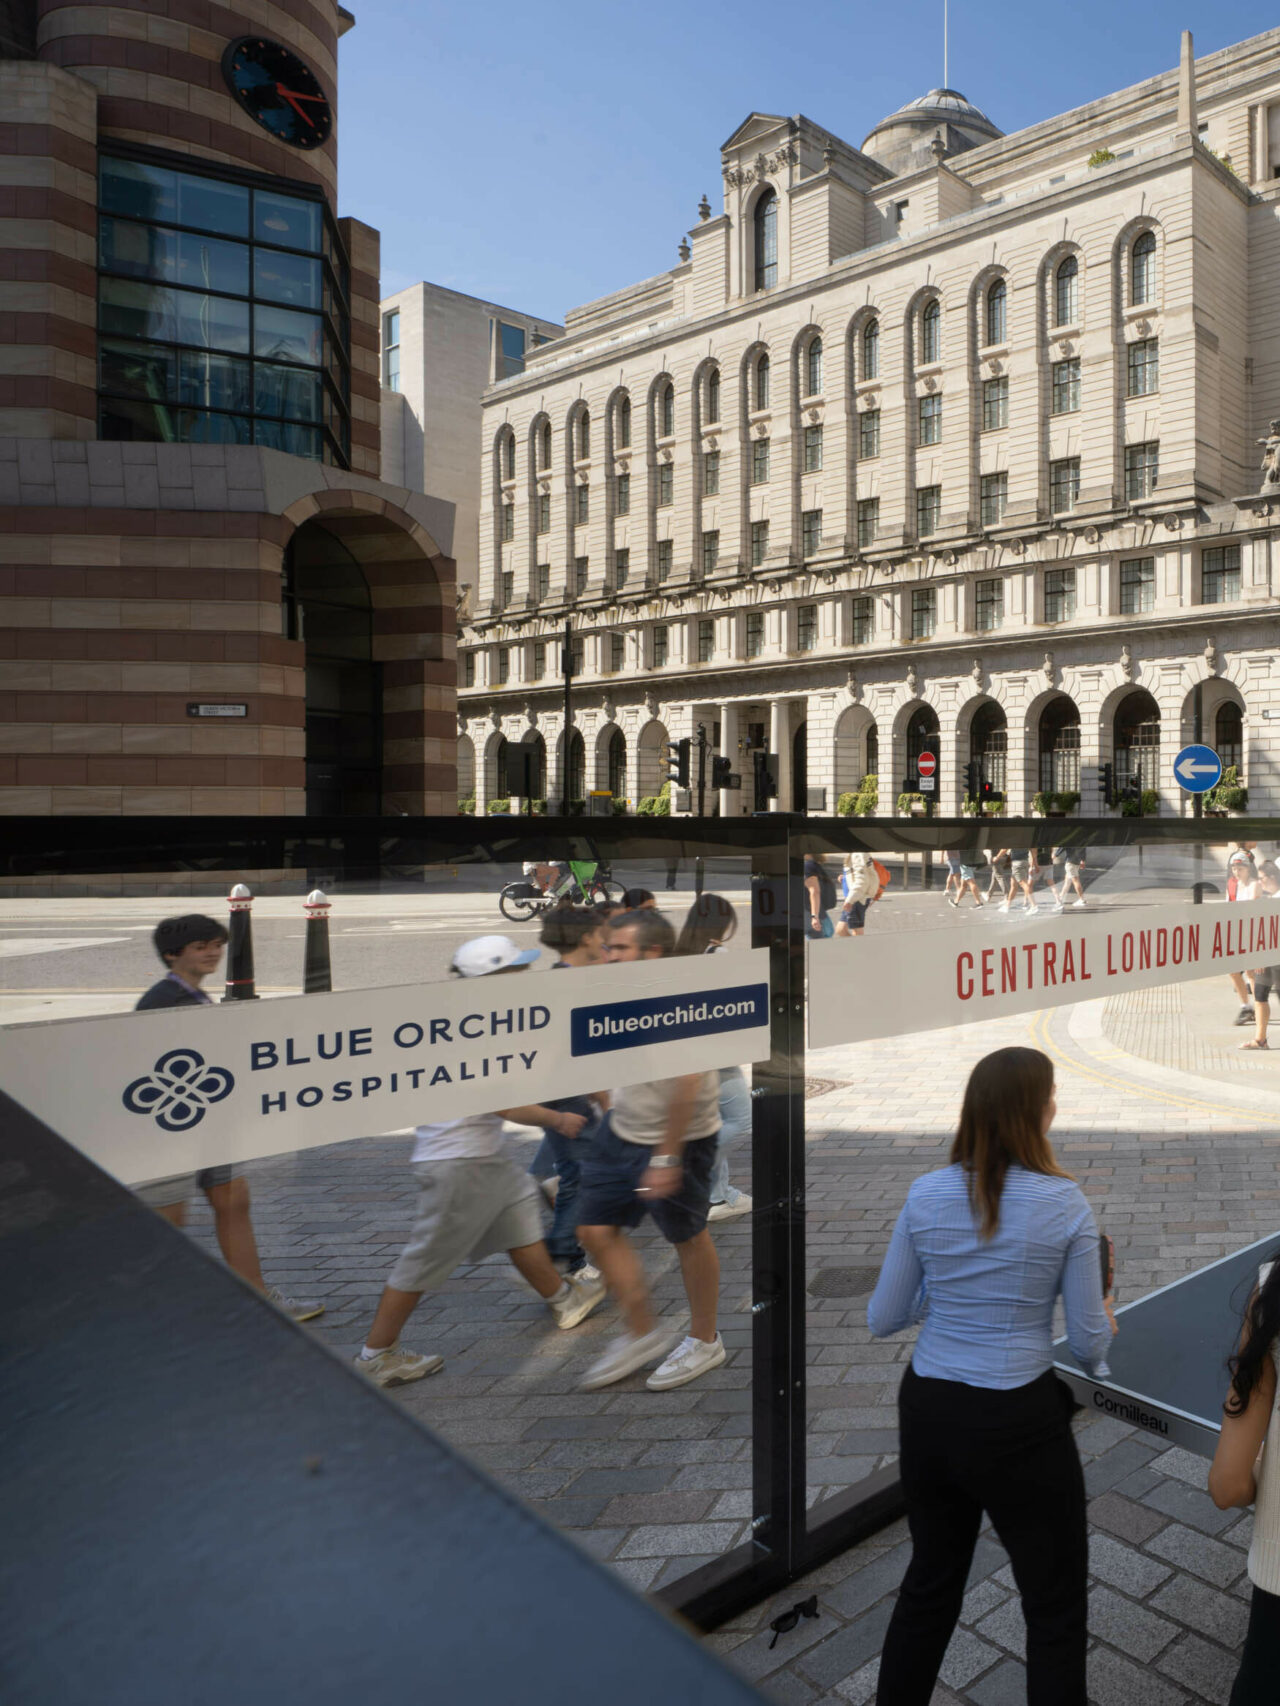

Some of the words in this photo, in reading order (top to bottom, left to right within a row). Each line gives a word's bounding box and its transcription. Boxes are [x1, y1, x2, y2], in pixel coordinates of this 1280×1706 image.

[956, 937, 1092, 1001] CENTRAL
[1107, 923, 1200, 975] LONDON
[250, 1027, 374, 1072] BLUE
[393, 1005, 551, 1049] ORCHID
[589, 1000, 755, 1037] blueorchid.com
[261, 1050, 538, 1115] HOSPITALITY
[1093, 1391, 1169, 1435] Cornilleau
